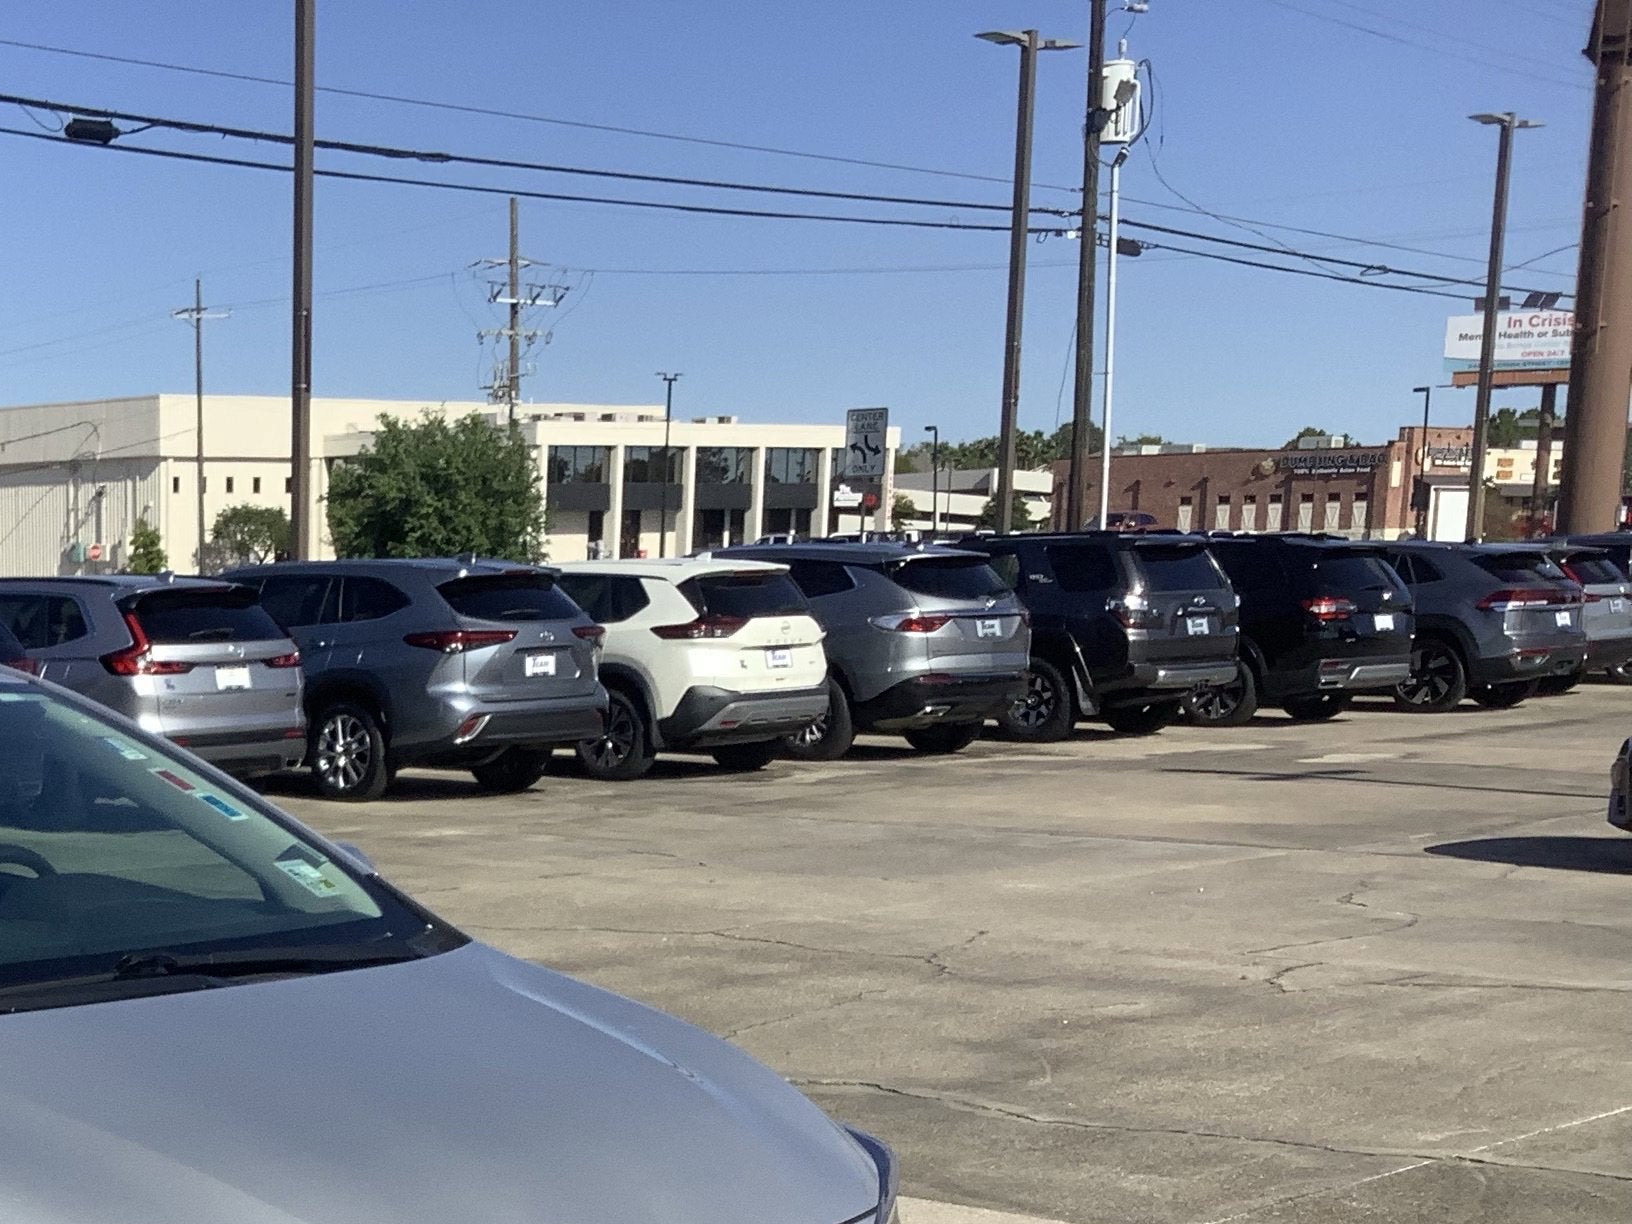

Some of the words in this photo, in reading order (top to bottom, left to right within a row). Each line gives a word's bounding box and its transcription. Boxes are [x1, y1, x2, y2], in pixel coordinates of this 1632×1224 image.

[1508, 317, 1522, 328] In
[1498, 331, 1535, 339] Health
[1552, 329, 1573, 337] Sub
[851, 412, 884, 421] CENTER
[852, 464, 876, 473] ONLY
